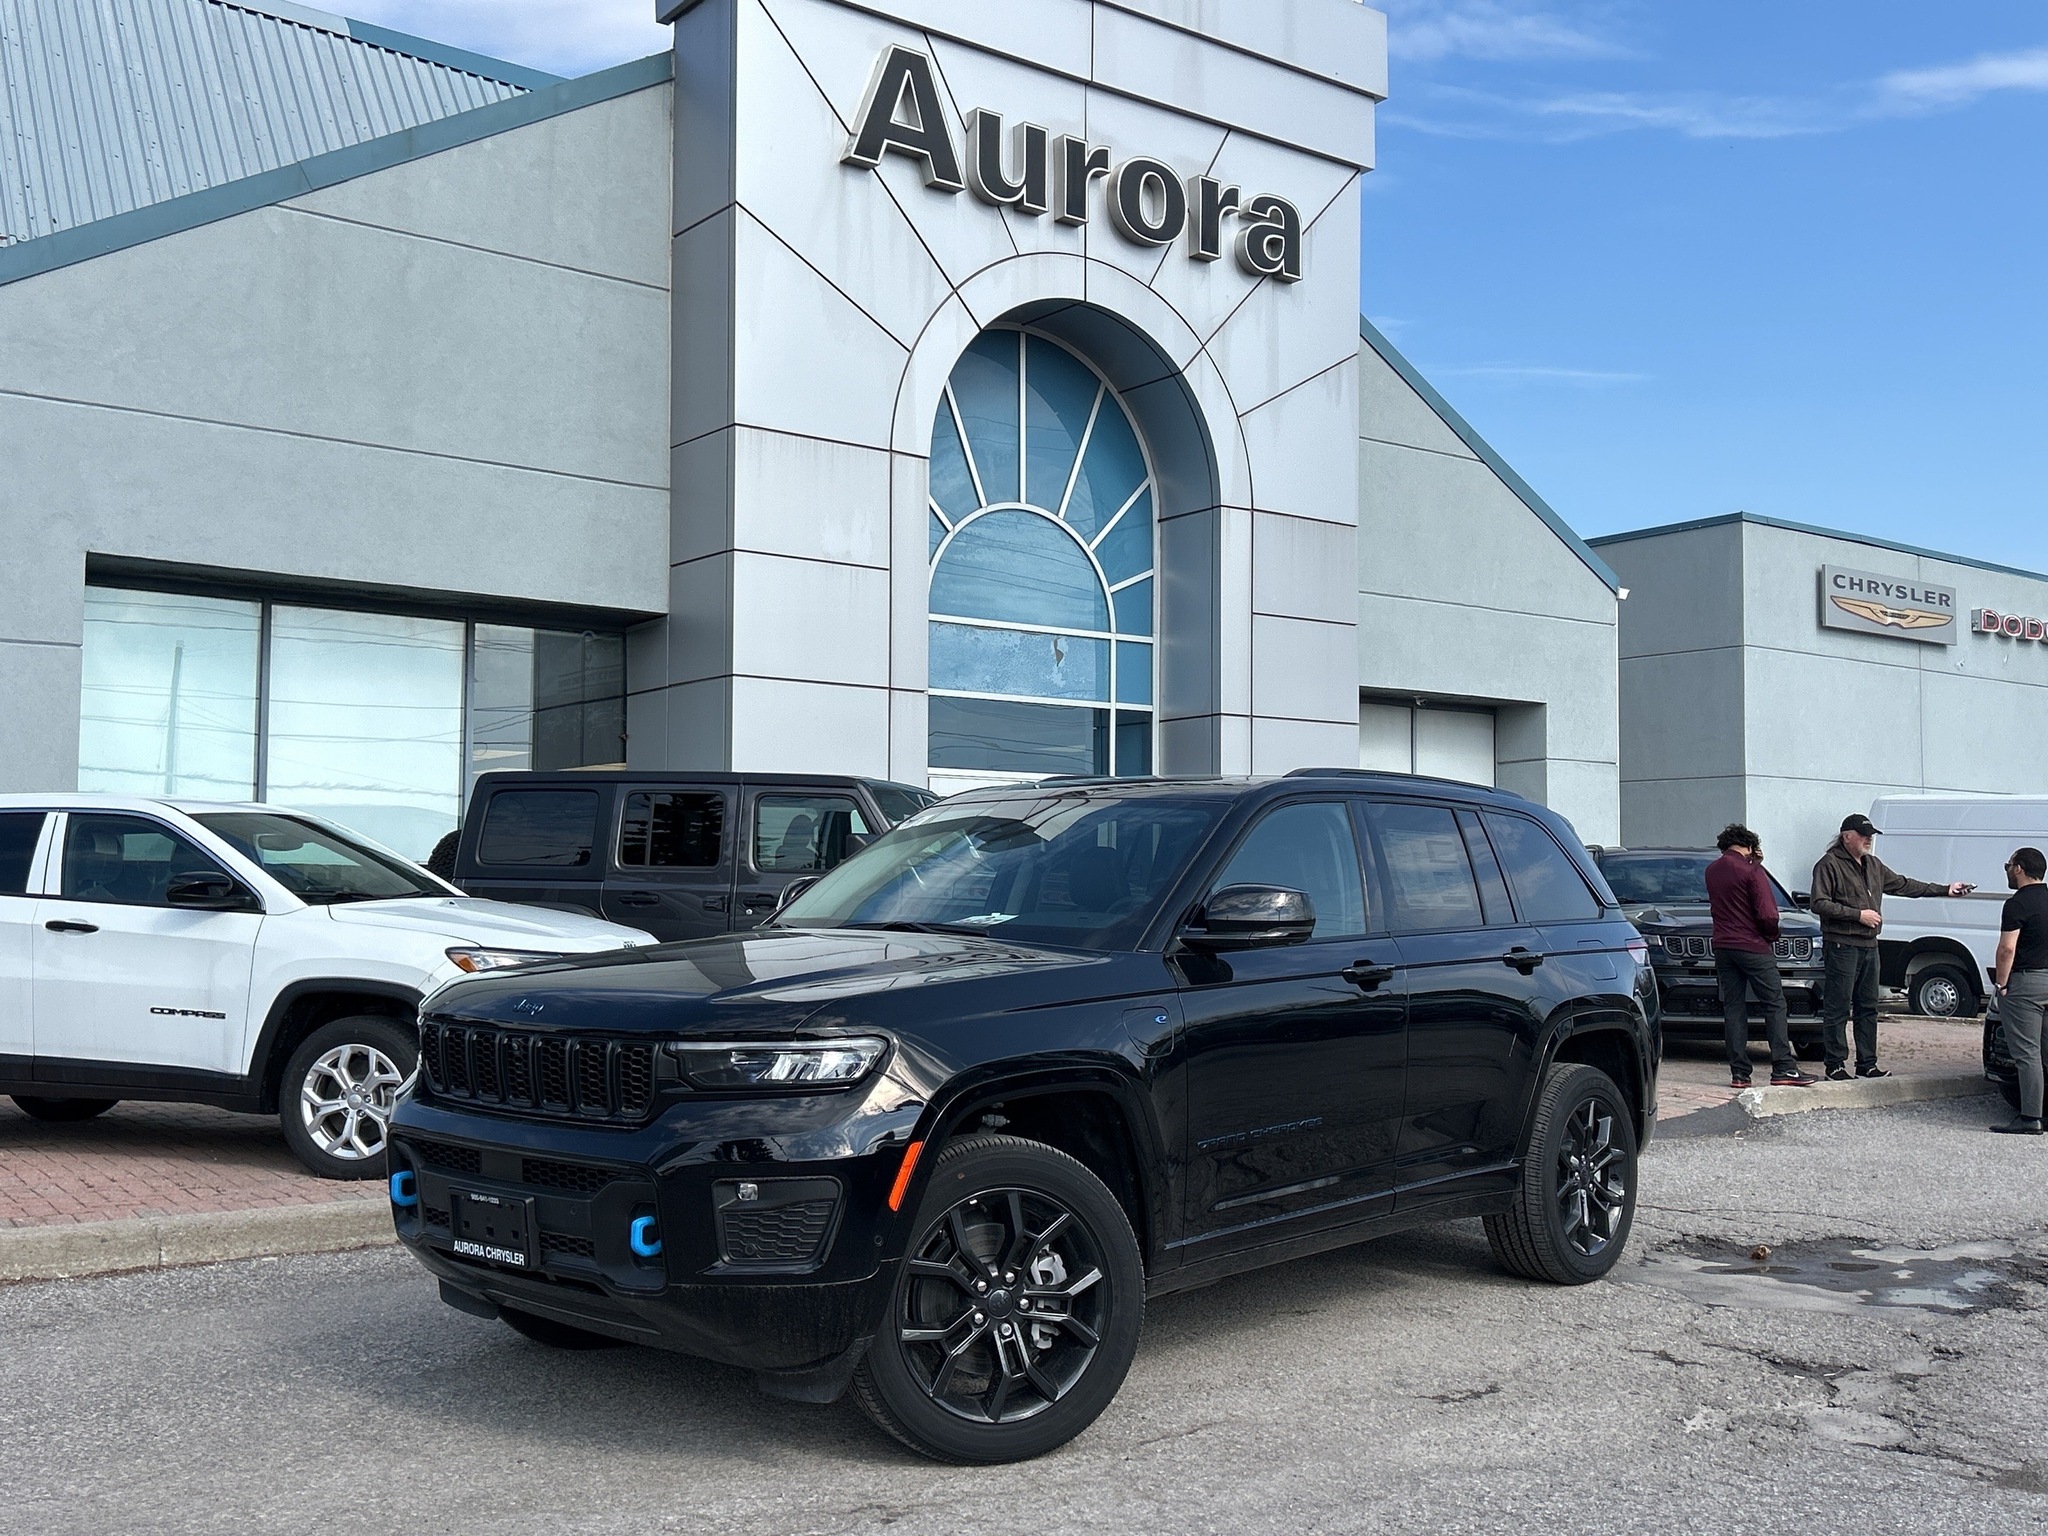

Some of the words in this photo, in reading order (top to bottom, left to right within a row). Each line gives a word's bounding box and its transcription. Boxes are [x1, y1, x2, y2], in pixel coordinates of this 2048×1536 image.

[841, 43, 1303, 283] Aurora
[1832, 574, 1951, 607] CHRYSLER
[1977, 608, 2048, 642] DOD
[150, 1007, 226, 1019] COMPASS
[453, 1241, 485, 1257] AURORA
[485, 1247, 525, 1266] CHRYSLER
